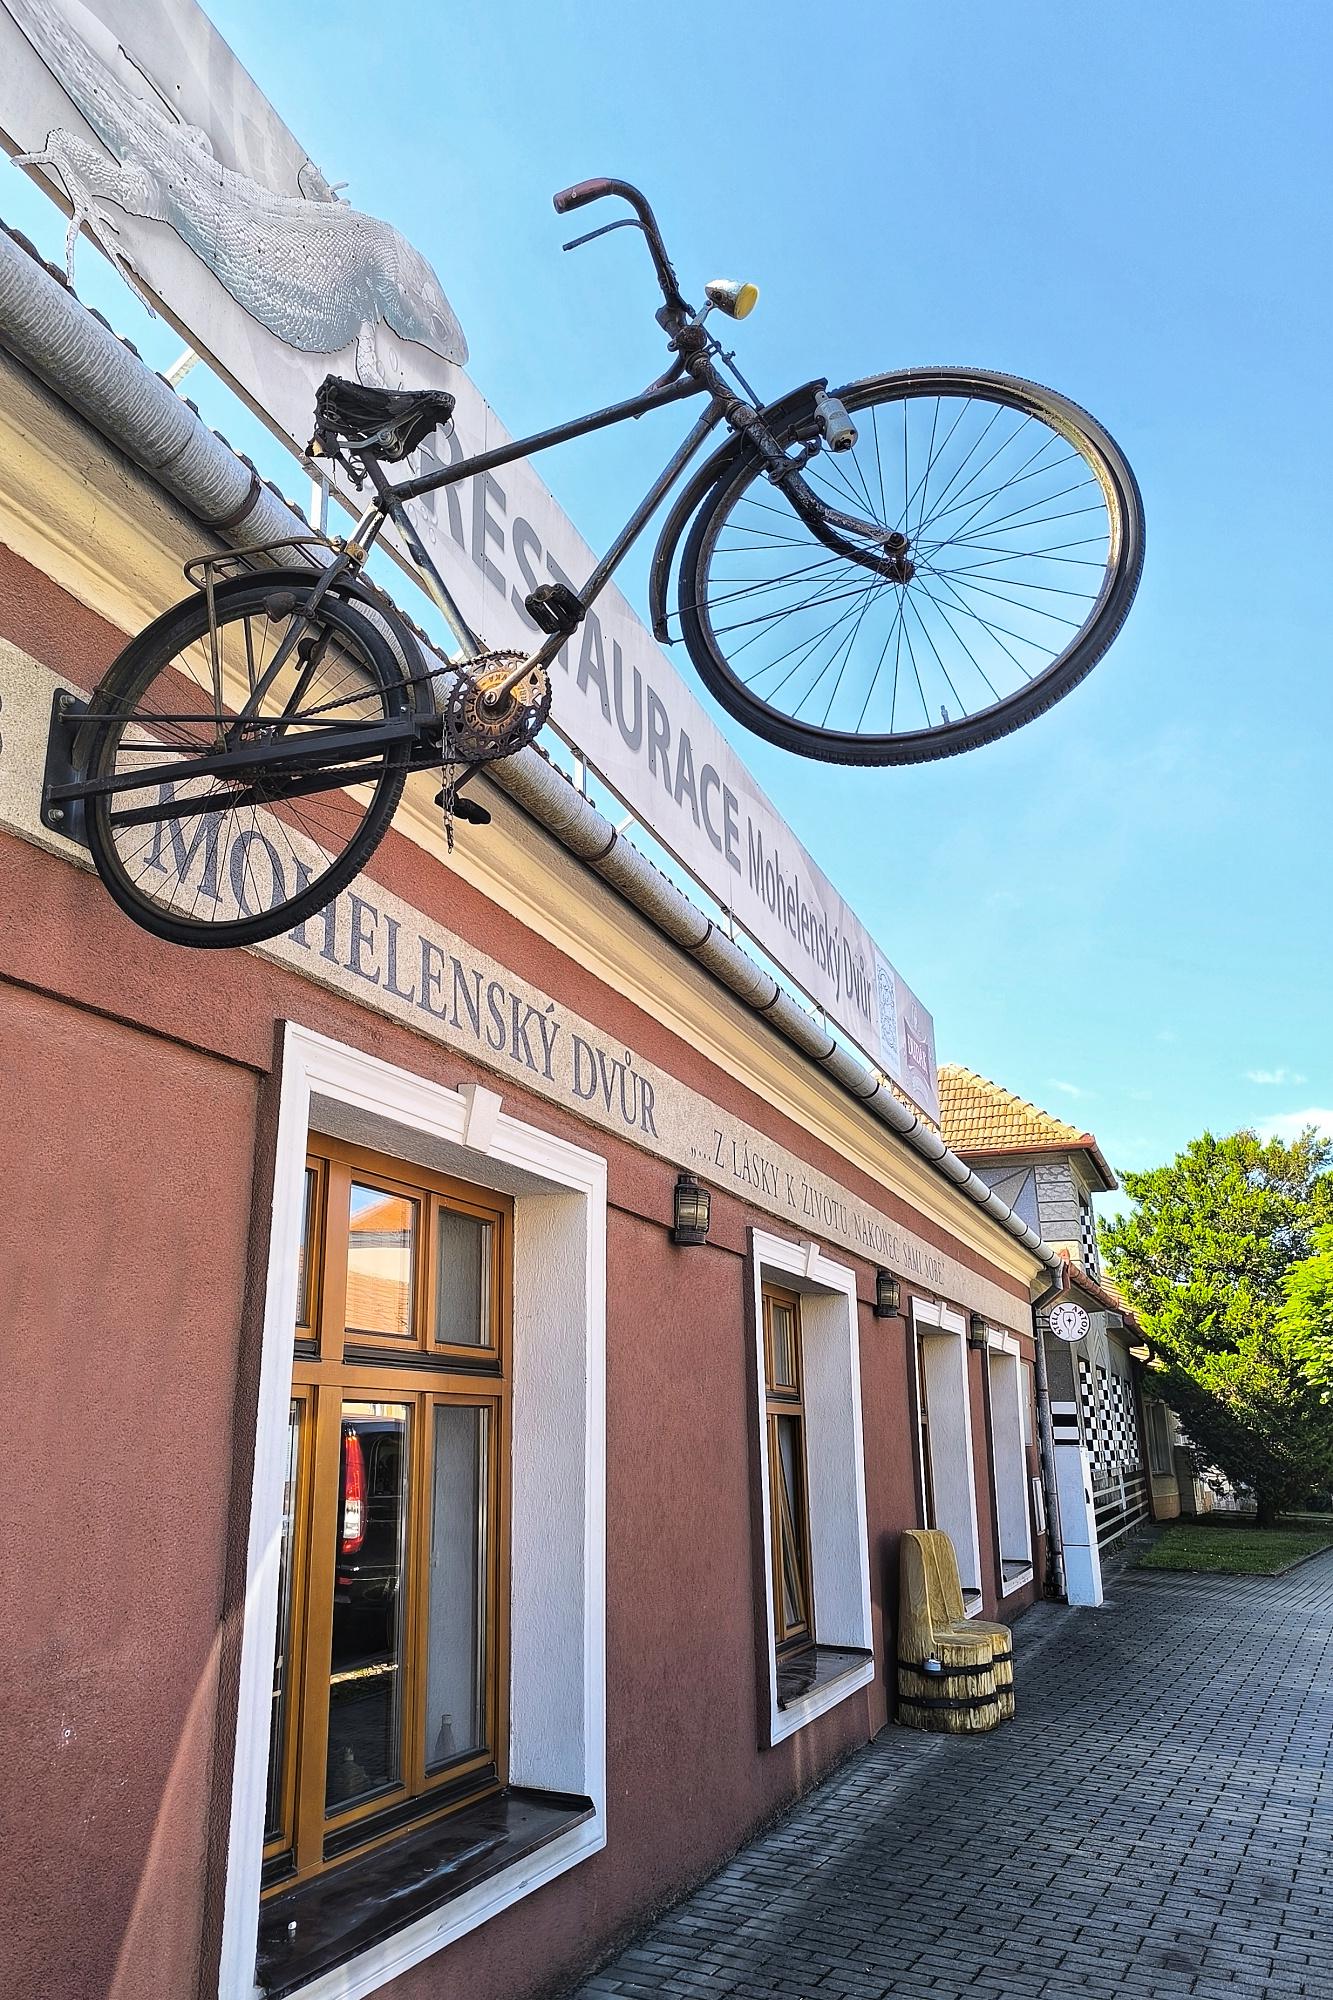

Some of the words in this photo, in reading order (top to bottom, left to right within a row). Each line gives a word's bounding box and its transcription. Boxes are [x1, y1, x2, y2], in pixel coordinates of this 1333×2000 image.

[419, 420, 742, 875] RESTAURACE
[748, 816, 840, 1004] Mohelenský
[843, 936, 872, 1024] Dvůr
[143, 783, 560, 1082] MOHELENSKÝ
[572, 1034, 659, 1139] DVŮR
[732, 1140, 778, 1198] LÁSKY
[786, 1172, 796, 1208] K
[801, 1172, 850, 1239] ŽIVOTU,
[852, 1212, 899, 1262] NAKONEC
[903, 1242, 922, 1274] SAMI
[1051, 1306, 1065, 1335] STELLA
[1072, 1306, 1088, 1336] ARTOIS
